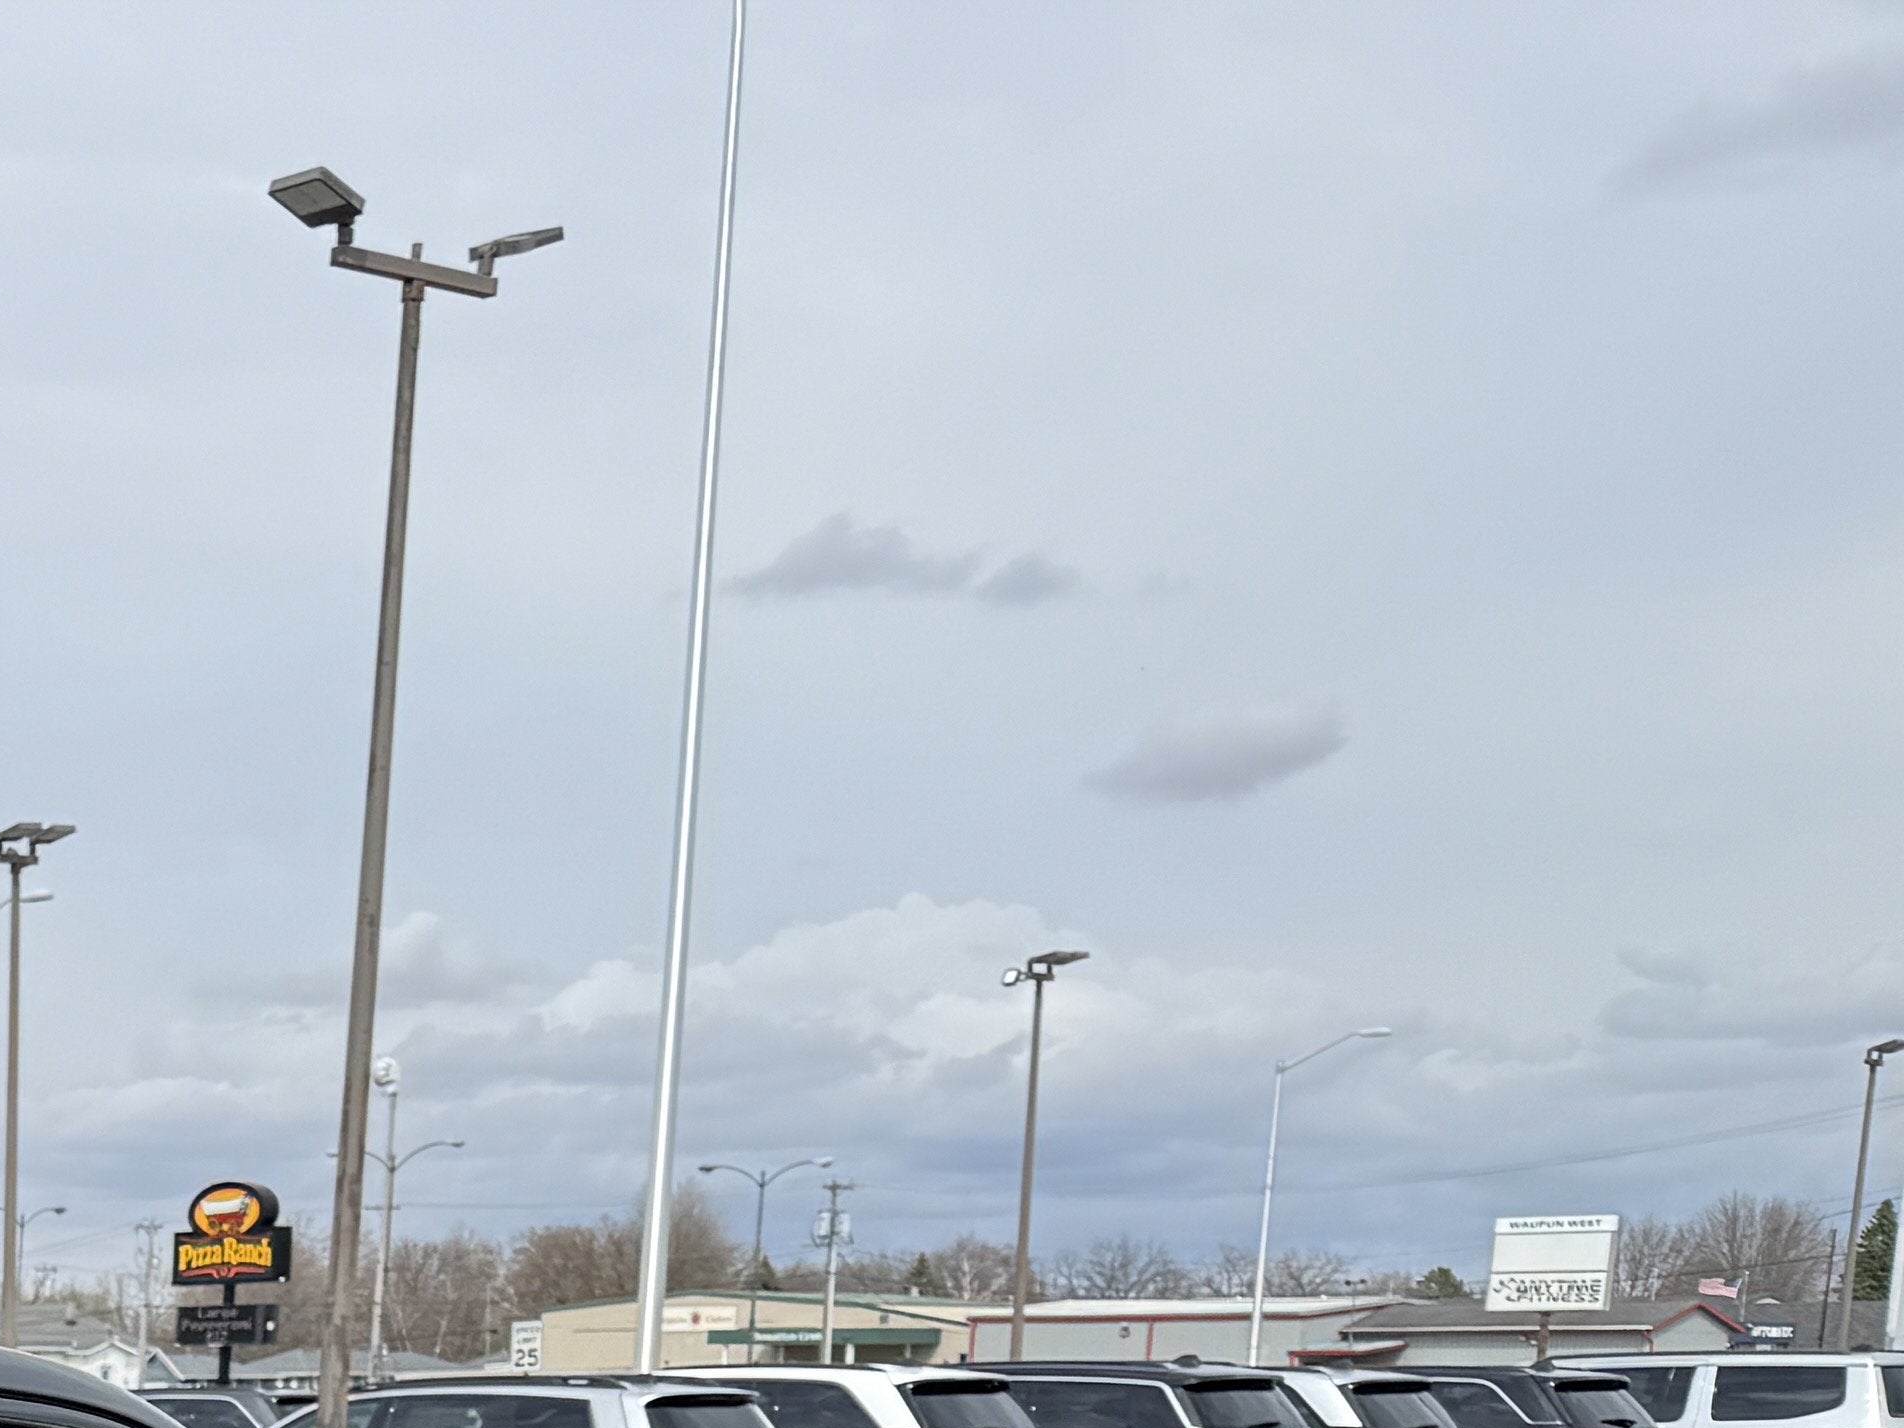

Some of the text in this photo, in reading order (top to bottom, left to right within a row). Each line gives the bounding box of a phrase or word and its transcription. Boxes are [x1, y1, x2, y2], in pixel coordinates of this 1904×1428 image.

[1567, 1218, 1603, 1228] WEST
[179, 1237, 272, 1271] Pizza Ranch
[515, 1349, 538, 1367] 25
